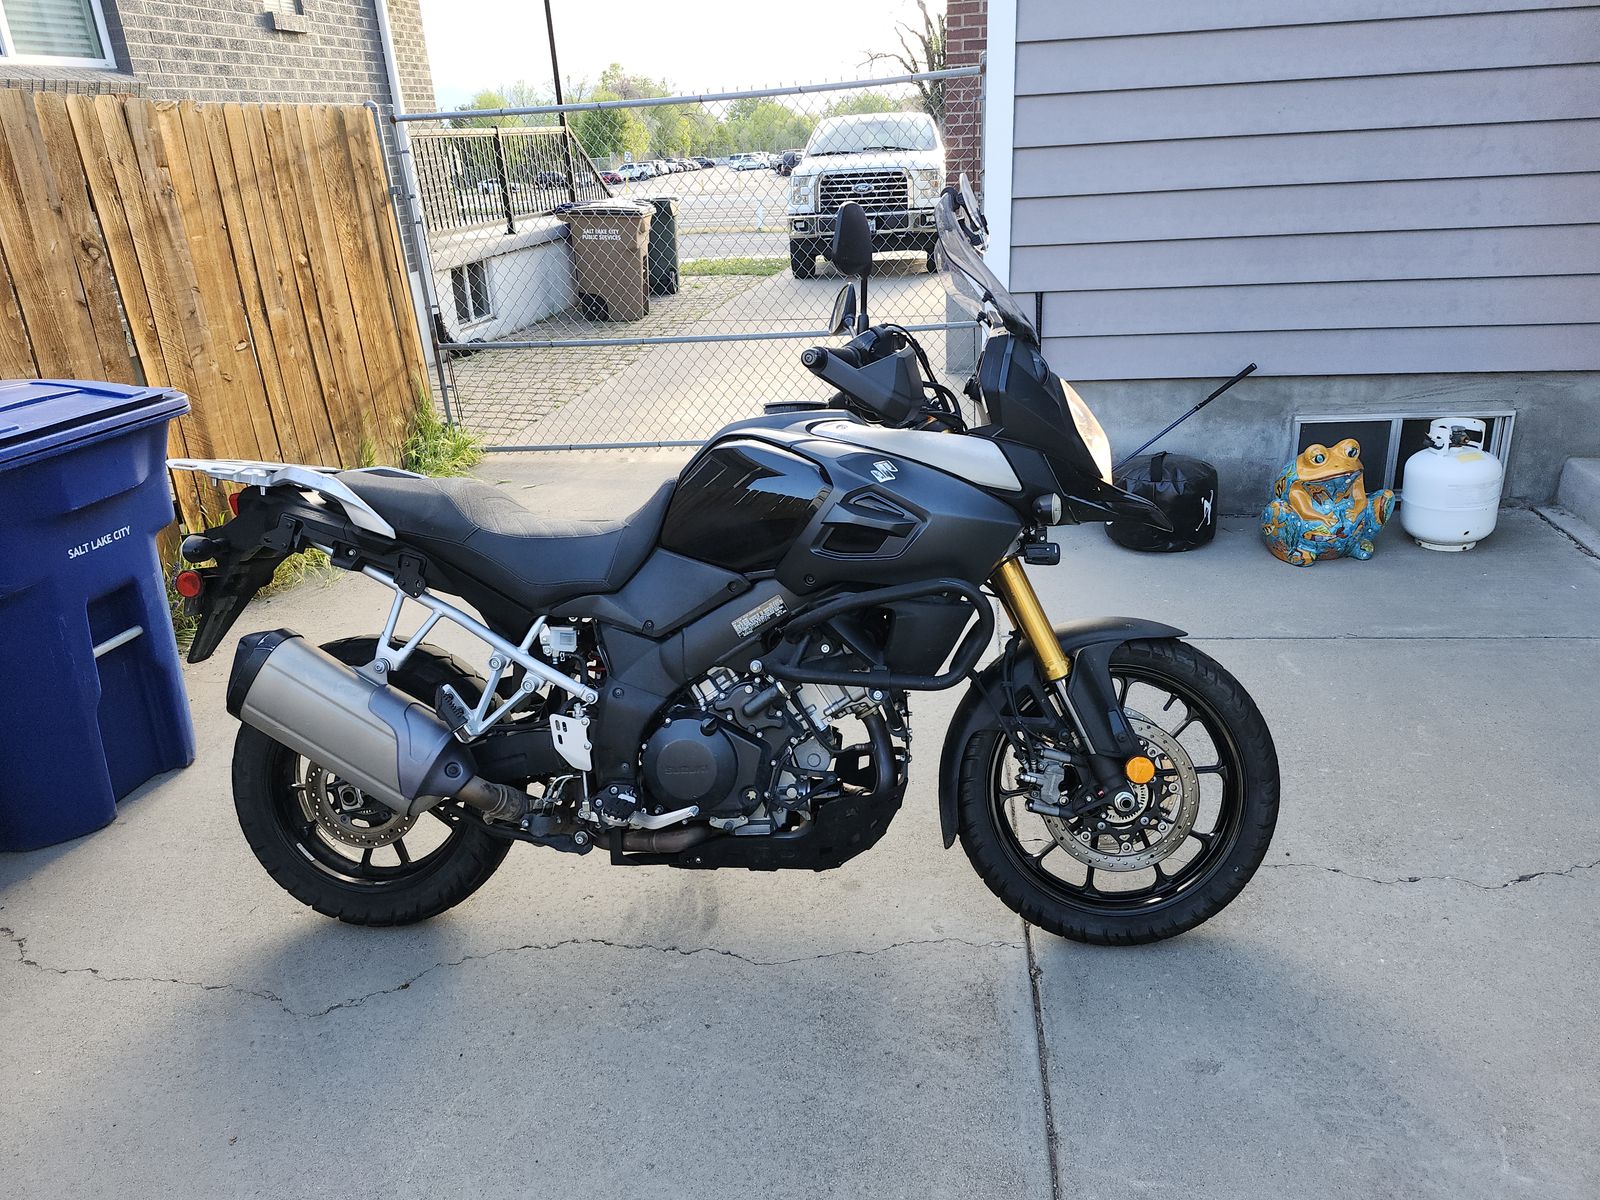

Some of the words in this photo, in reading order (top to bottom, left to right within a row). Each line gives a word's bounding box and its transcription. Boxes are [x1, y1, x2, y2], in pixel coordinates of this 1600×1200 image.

[67, 542, 89, 559] SALT
[91, 533, 113, 551] LAKE
[113, 525, 130, 540] CITY
